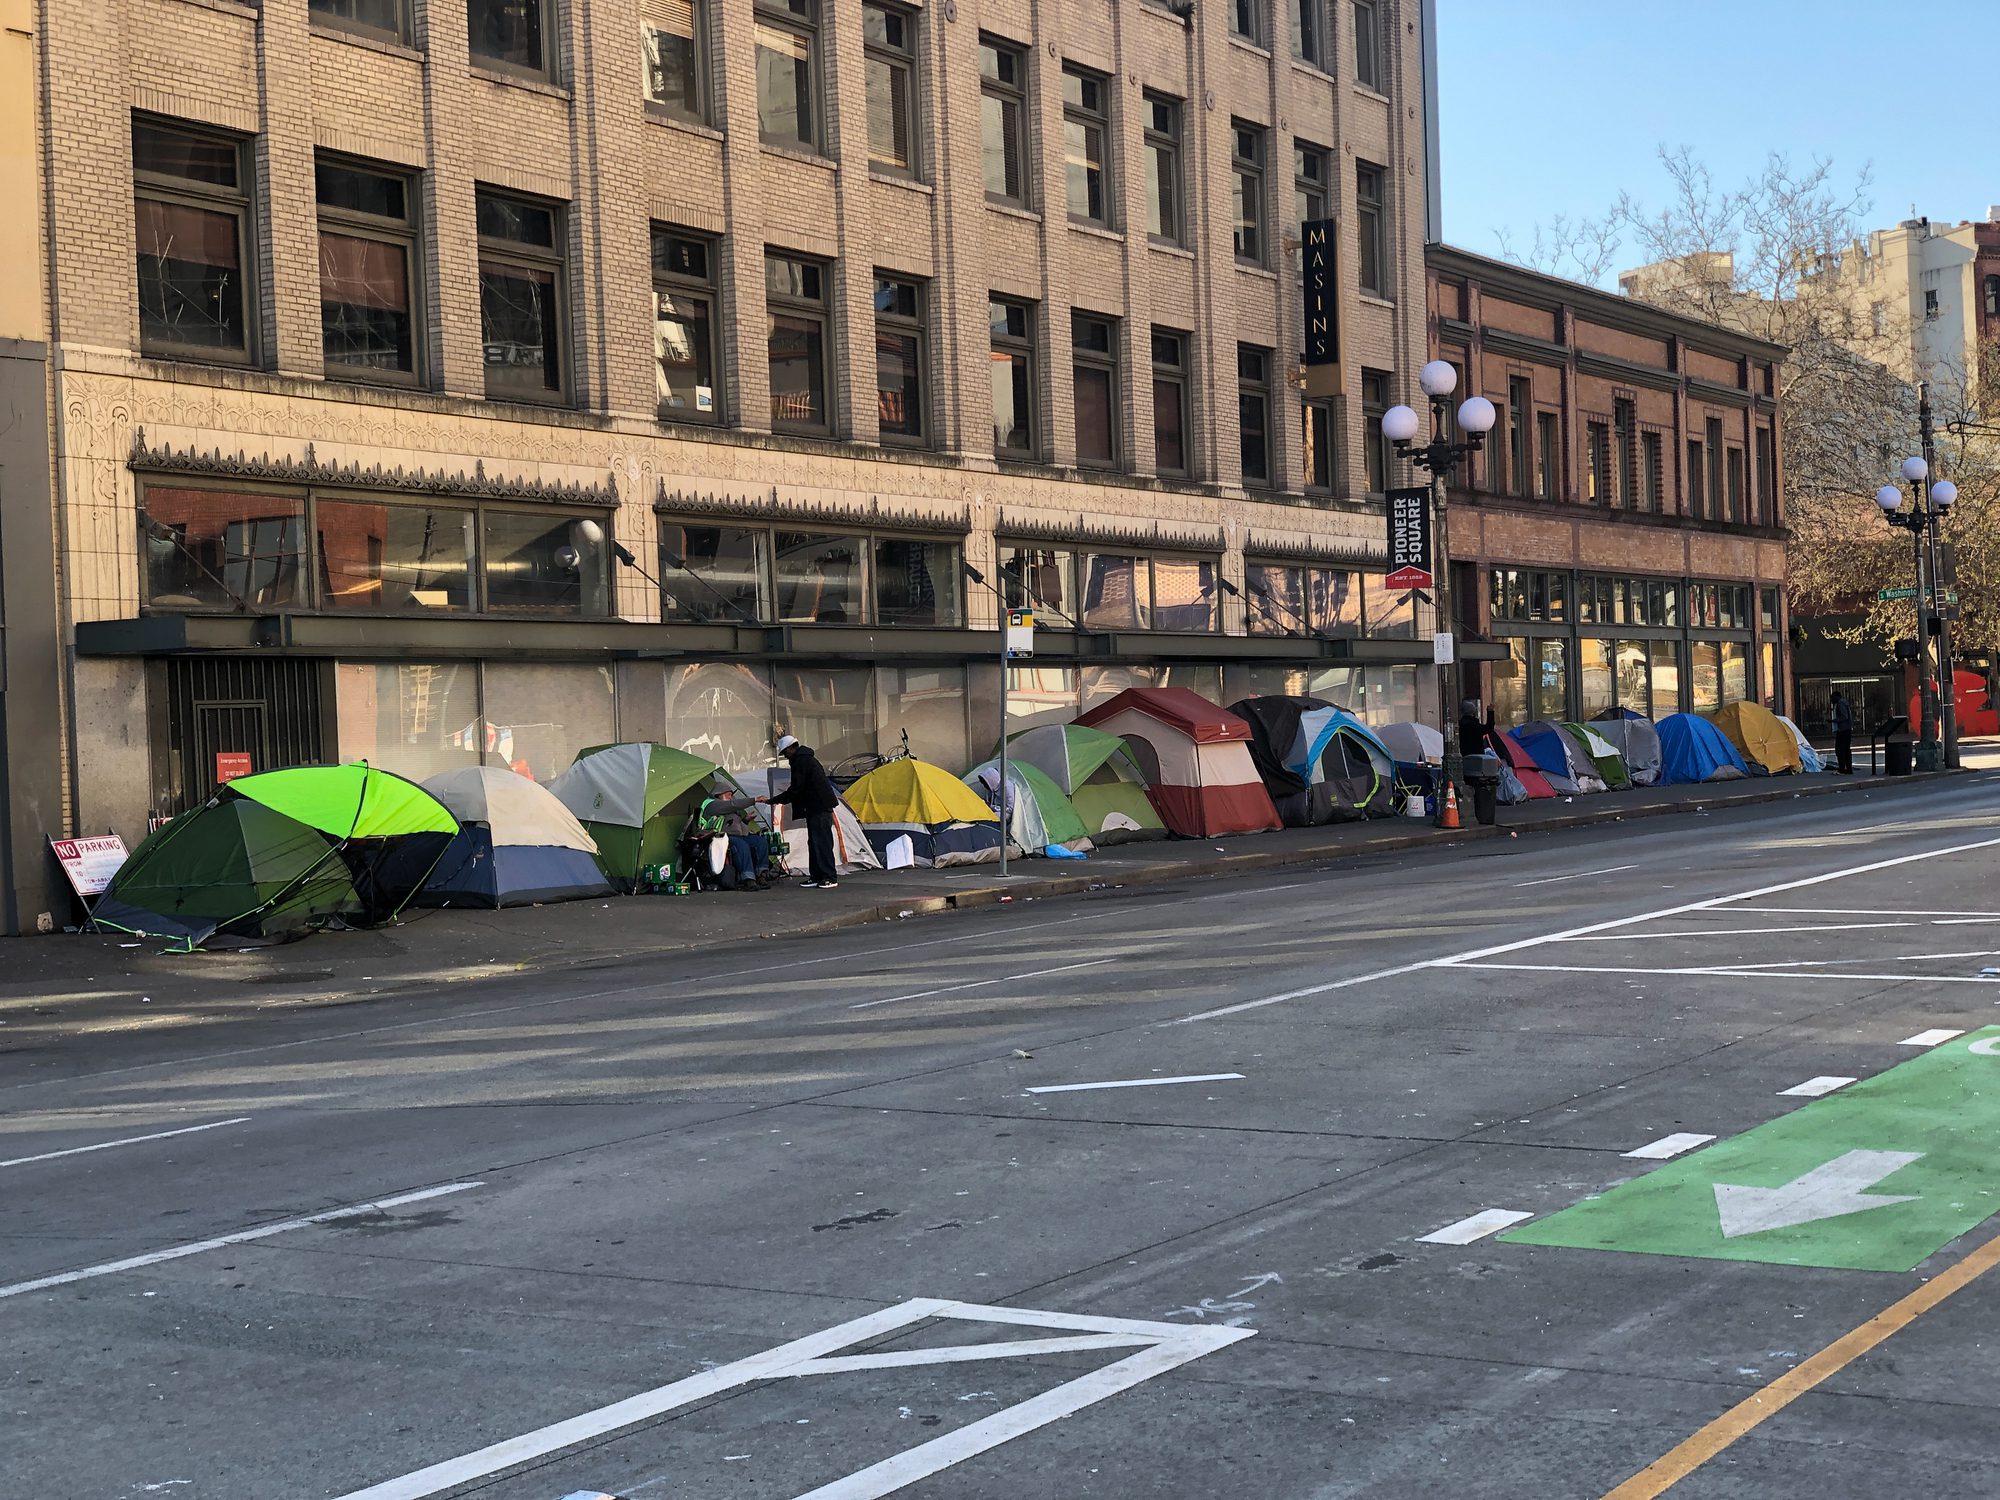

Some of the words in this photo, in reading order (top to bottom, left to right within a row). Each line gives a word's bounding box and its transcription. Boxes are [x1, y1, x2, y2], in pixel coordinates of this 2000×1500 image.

[1310, 228, 1327, 356] MASINS
[1394, 498, 1407, 564] PIONEER
[1408, 497, 1423, 563] SQUARE
[1886, 588, 1918, 599] Washingto
[57, 843, 76, 858] NO
[78, 839, 121, 853] PARKING
